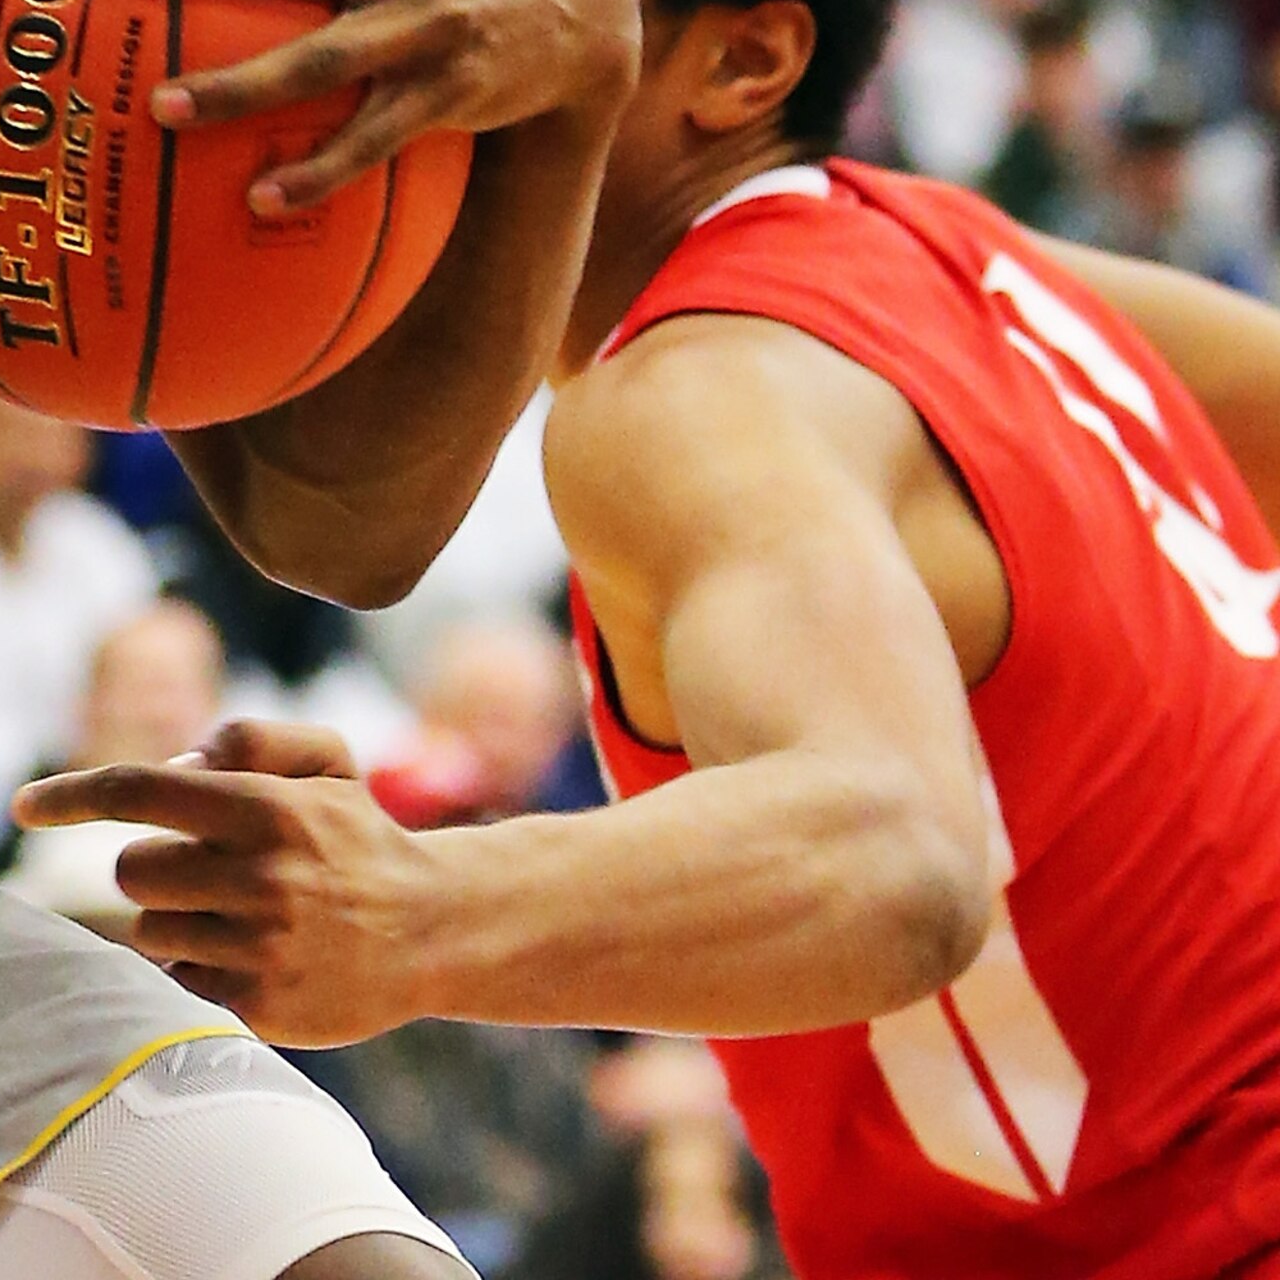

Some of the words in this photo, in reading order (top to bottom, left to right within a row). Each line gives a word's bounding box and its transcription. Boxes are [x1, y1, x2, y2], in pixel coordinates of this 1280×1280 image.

[112, 17, 142, 114] DESIGN
[55, 86, 95, 257] LEGACY
[104, 128, 128, 244] CHANNEL
